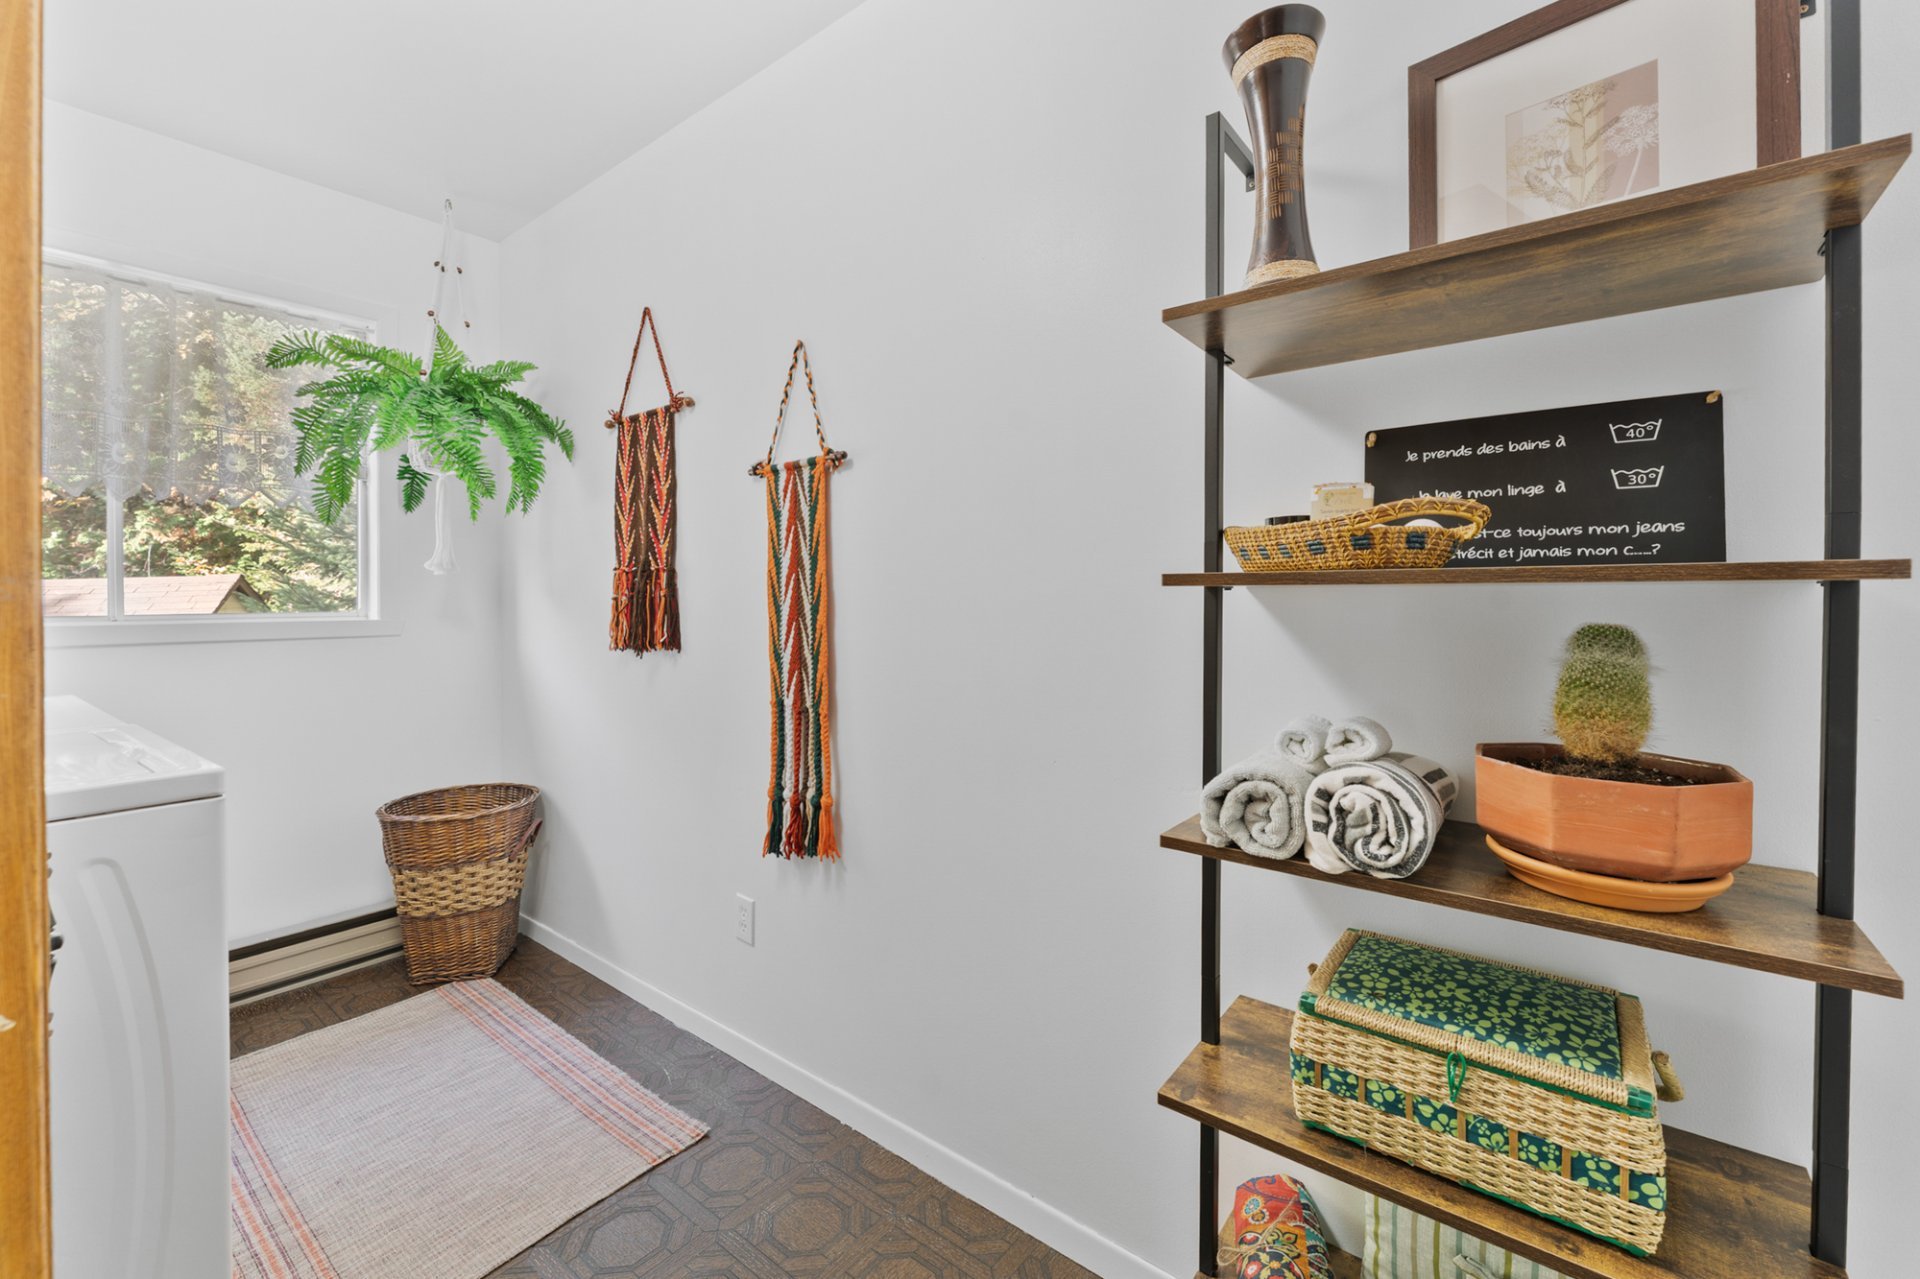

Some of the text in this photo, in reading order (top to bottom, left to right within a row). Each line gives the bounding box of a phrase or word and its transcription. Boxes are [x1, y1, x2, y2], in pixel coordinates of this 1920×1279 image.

[1405, 434, 1567, 463] Je prends des bains à
[1434, 489, 1463, 500] lave
[1467, 488, 1503, 499] mon
[1507, 484, 1545, 498] linge
[1554, 479, 1567, 494] à
[1516, 524, 1584, 541] toujours
[1588, 524, 1630, 535] mon
[1631, 521, 1686, 538] jeans
[1497, 547, 1515, 559] et
[1515, 546, 1572, 562] jamais
[1576, 547, 1618, 557] mon
